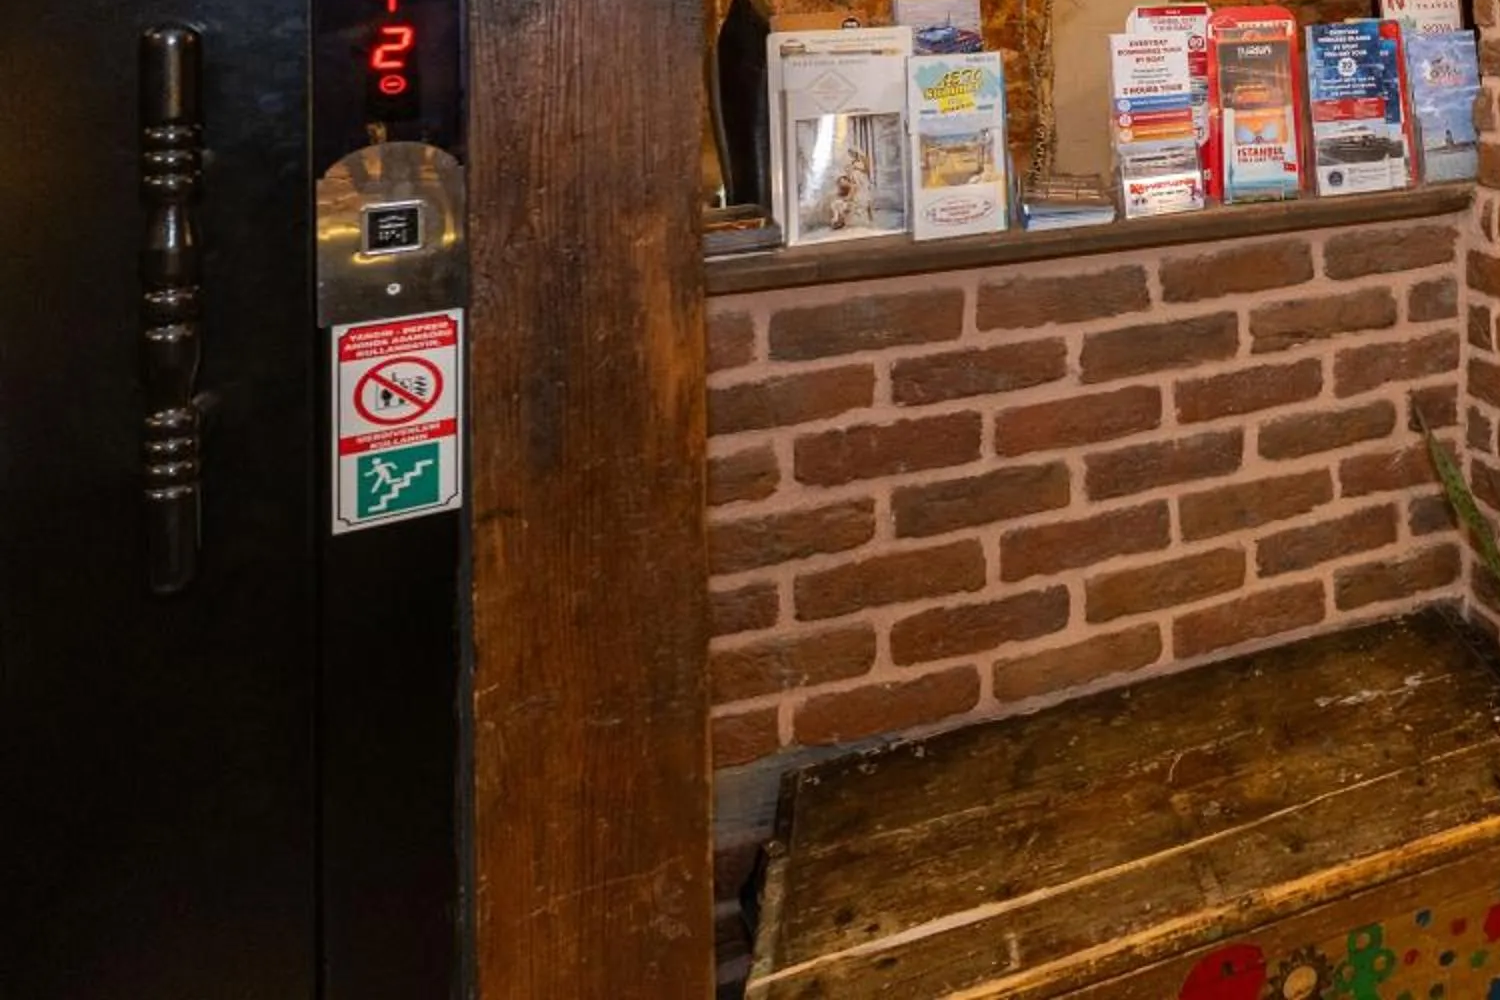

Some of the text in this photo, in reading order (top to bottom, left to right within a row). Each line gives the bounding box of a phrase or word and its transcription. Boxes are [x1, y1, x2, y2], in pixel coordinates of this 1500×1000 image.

[1128, 39, 1168, 47] EVERYDAY
[371, 26, 415, 69] 2
[1146, 55, 1165, 63] BOAT
[1130, 85, 1159, 94] HOURS
